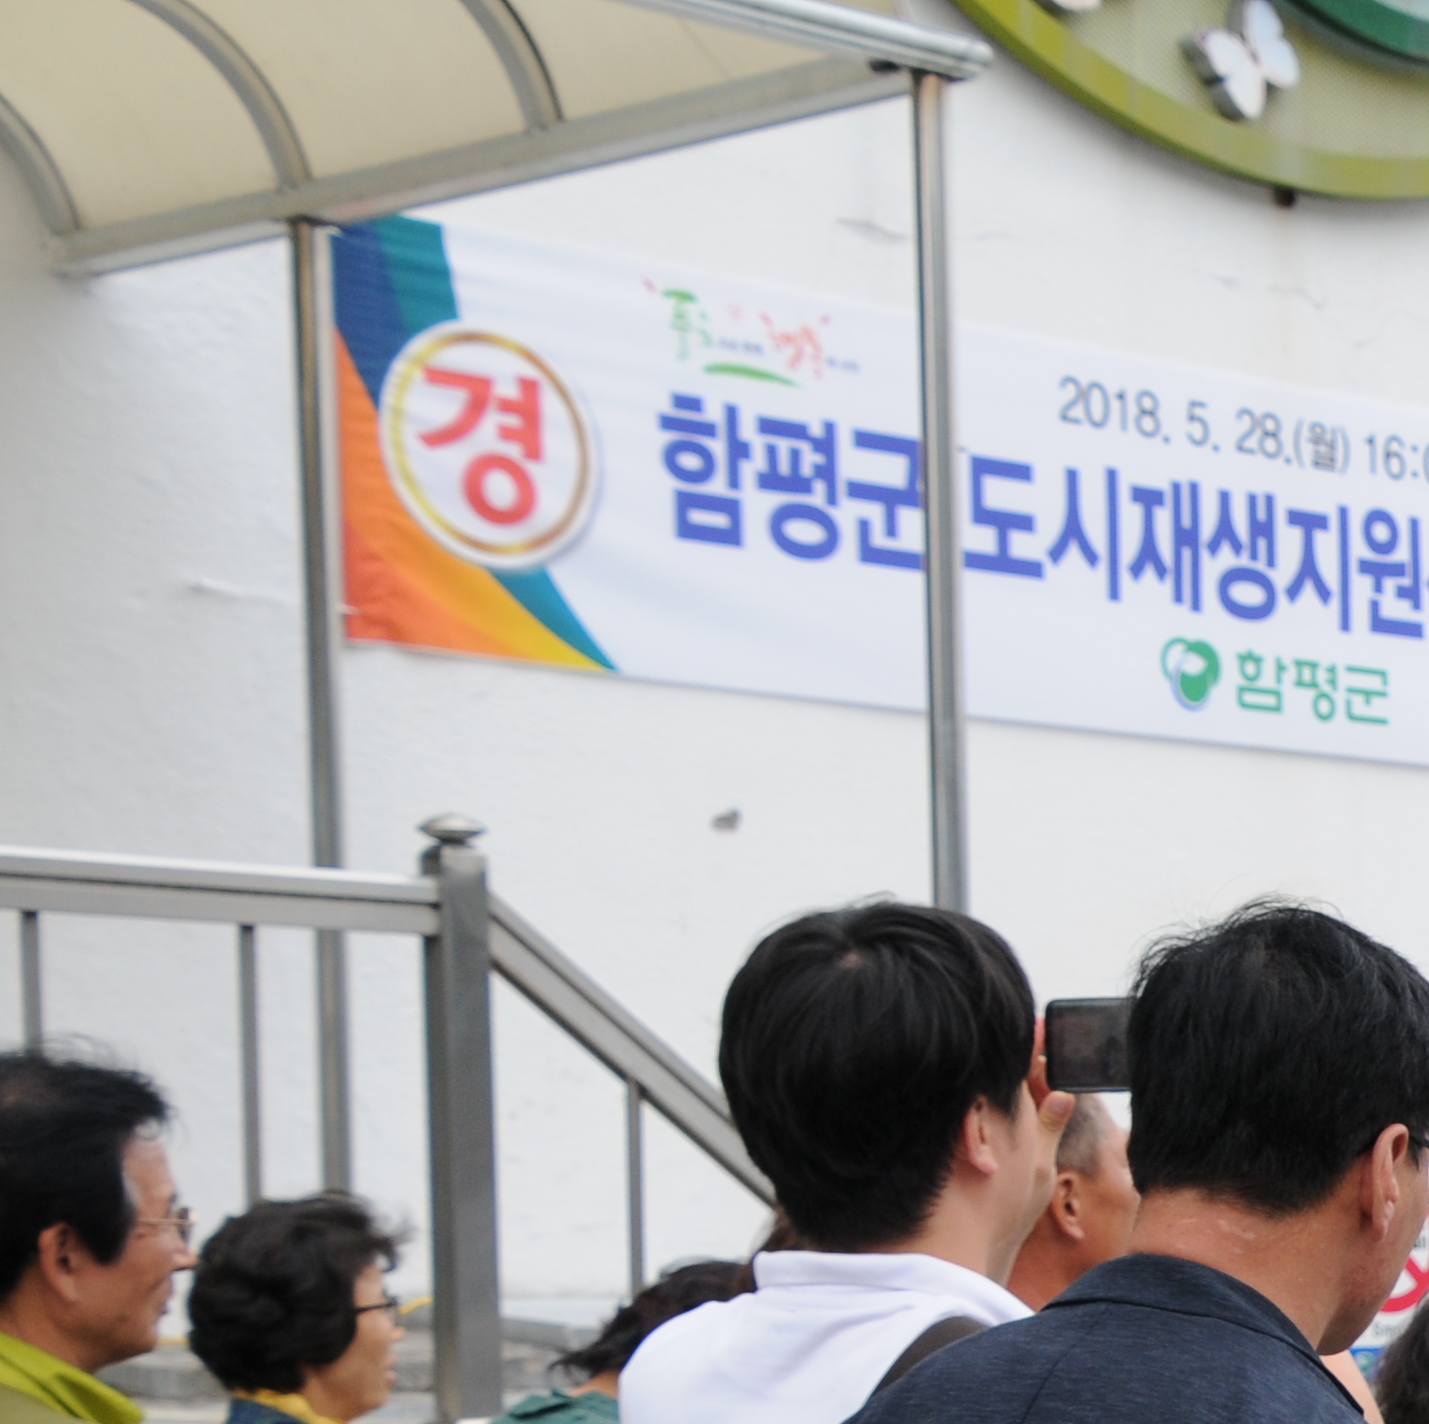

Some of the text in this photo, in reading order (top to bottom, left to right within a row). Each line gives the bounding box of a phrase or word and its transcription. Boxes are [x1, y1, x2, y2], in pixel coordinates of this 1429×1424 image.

[418, 364, 545, 527] 경
[1059, 375, 1171, 445] 2018.
[1186, 399, 1221, 453] 5.
[657, 391, 923, 572] 함평군
[1235, 649, 1390, 726] 함평군
